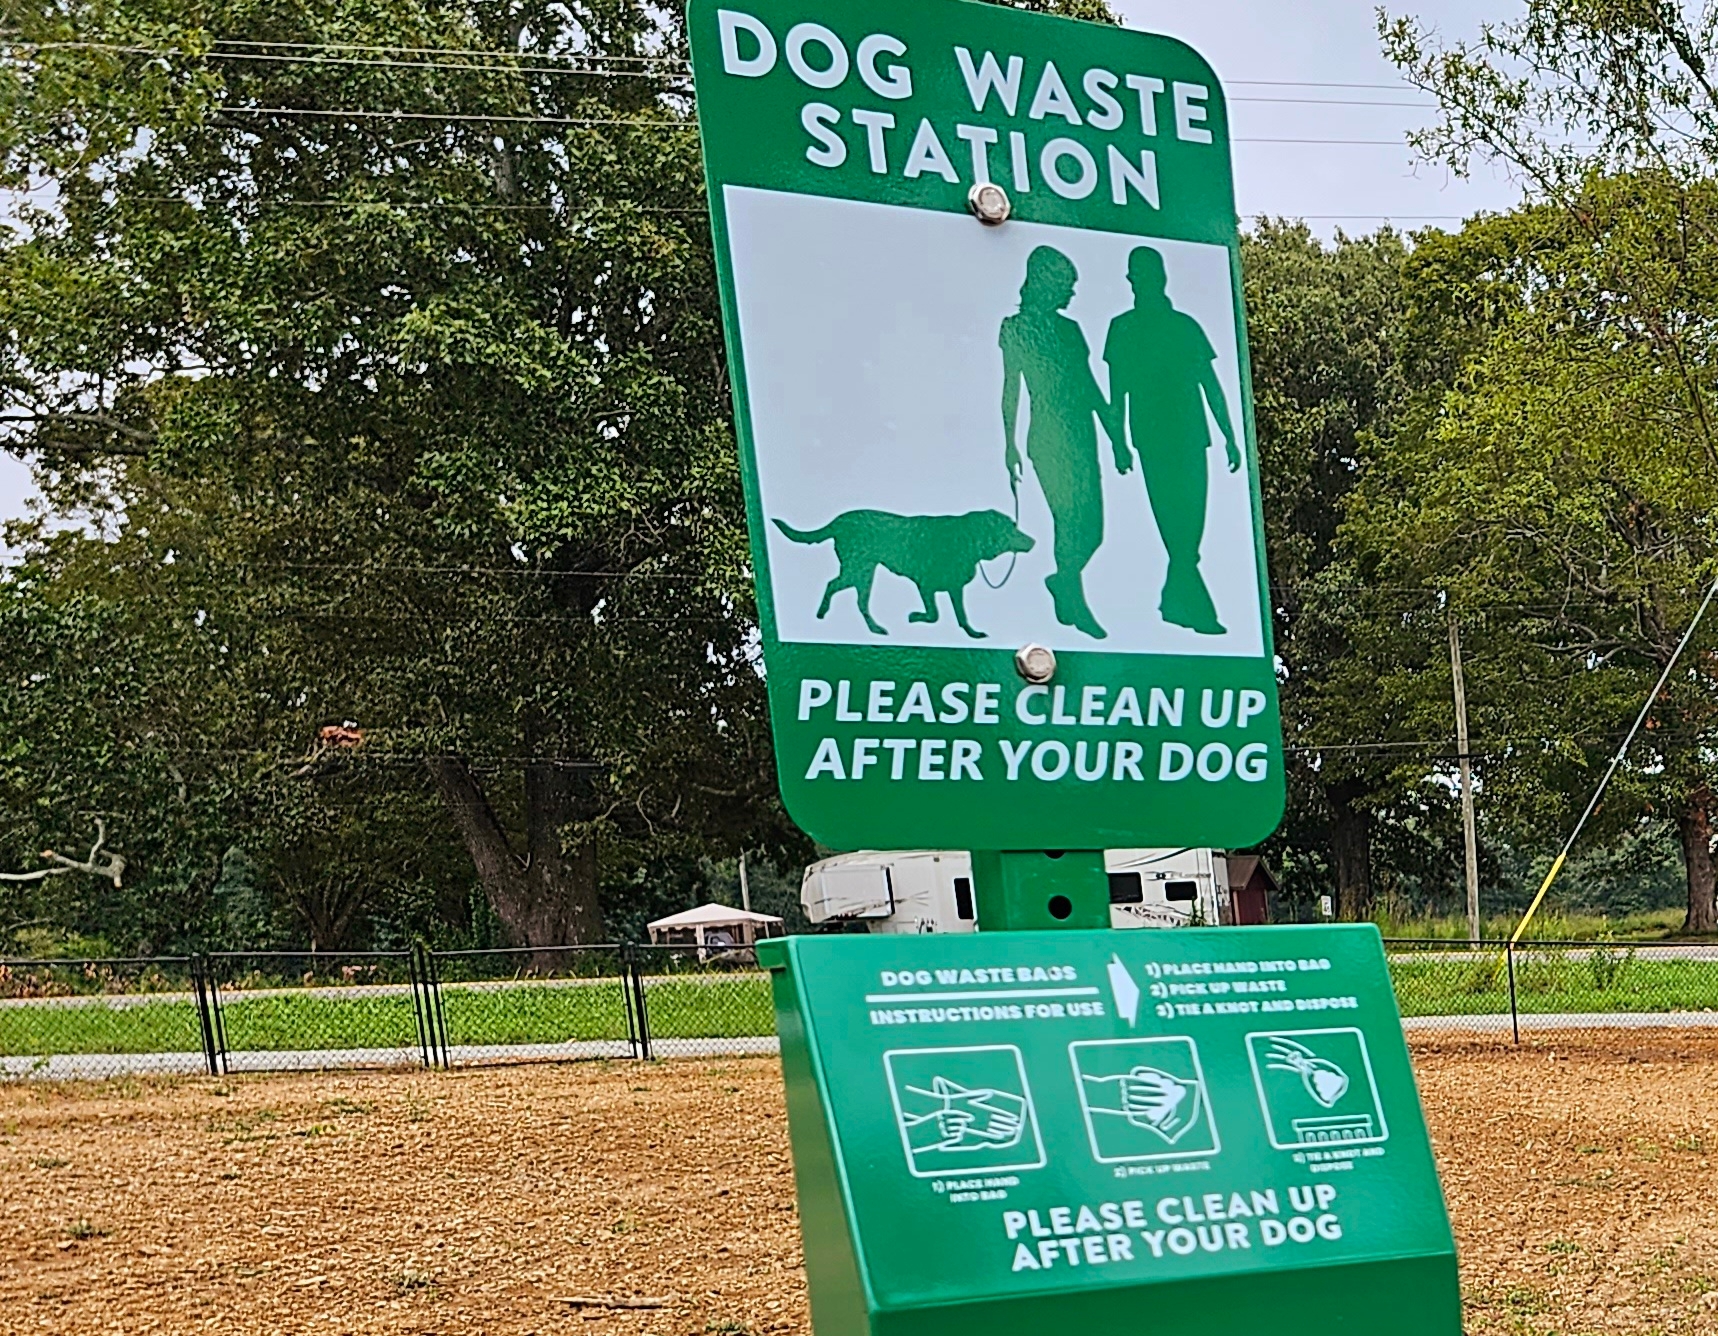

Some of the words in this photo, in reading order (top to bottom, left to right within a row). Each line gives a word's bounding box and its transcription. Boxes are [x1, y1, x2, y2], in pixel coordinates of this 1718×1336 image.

[717, 8, 913, 99] DOG
[954, 45, 1213, 145] WASTE
[801, 102, 1160, 211] STATION
[798, 678, 1001, 725] PLEASE
[1015, 684, 1185, 727] CLEAN
[1199, 688, 1267, 728] UP
[804, 736, 984, 781] AFTER
[998, 740, 1145, 782] YOUR
[1157, 741, 1269, 782] DOG
[880, 970, 932, 987] DOG
[934, 967, 1015, 985] WASTE
[1162, 962, 1213, 976] PLACE
[1297, 958, 1331, 971] BAG
[1169, 982, 1208, 995] PICK
[1208, 980, 1231, 994] UP
[1231, 979, 1287, 993] WASTE
[869, 1004, 1023, 1025] INSTRUCTIONS
[1024, 1002, 1066, 1019] FOR
[1066, 1001, 1105, 1017] USE
[1215, 1000, 1259, 1014] KNOT
[1261, 999, 1294, 1012] AND
[1295, 996, 1358, 1011] DISPOSE
[1003, 1200, 1148, 1239] PLEASE
[1156, 1188, 1280, 1225] CLEAN
[1288, 1184, 1337, 1213] UP
[1011, 1233, 1135, 1272] AFTER
[1140, 1221, 1251, 1258] YOUR
[1259, 1213, 1343, 1246] DOG
